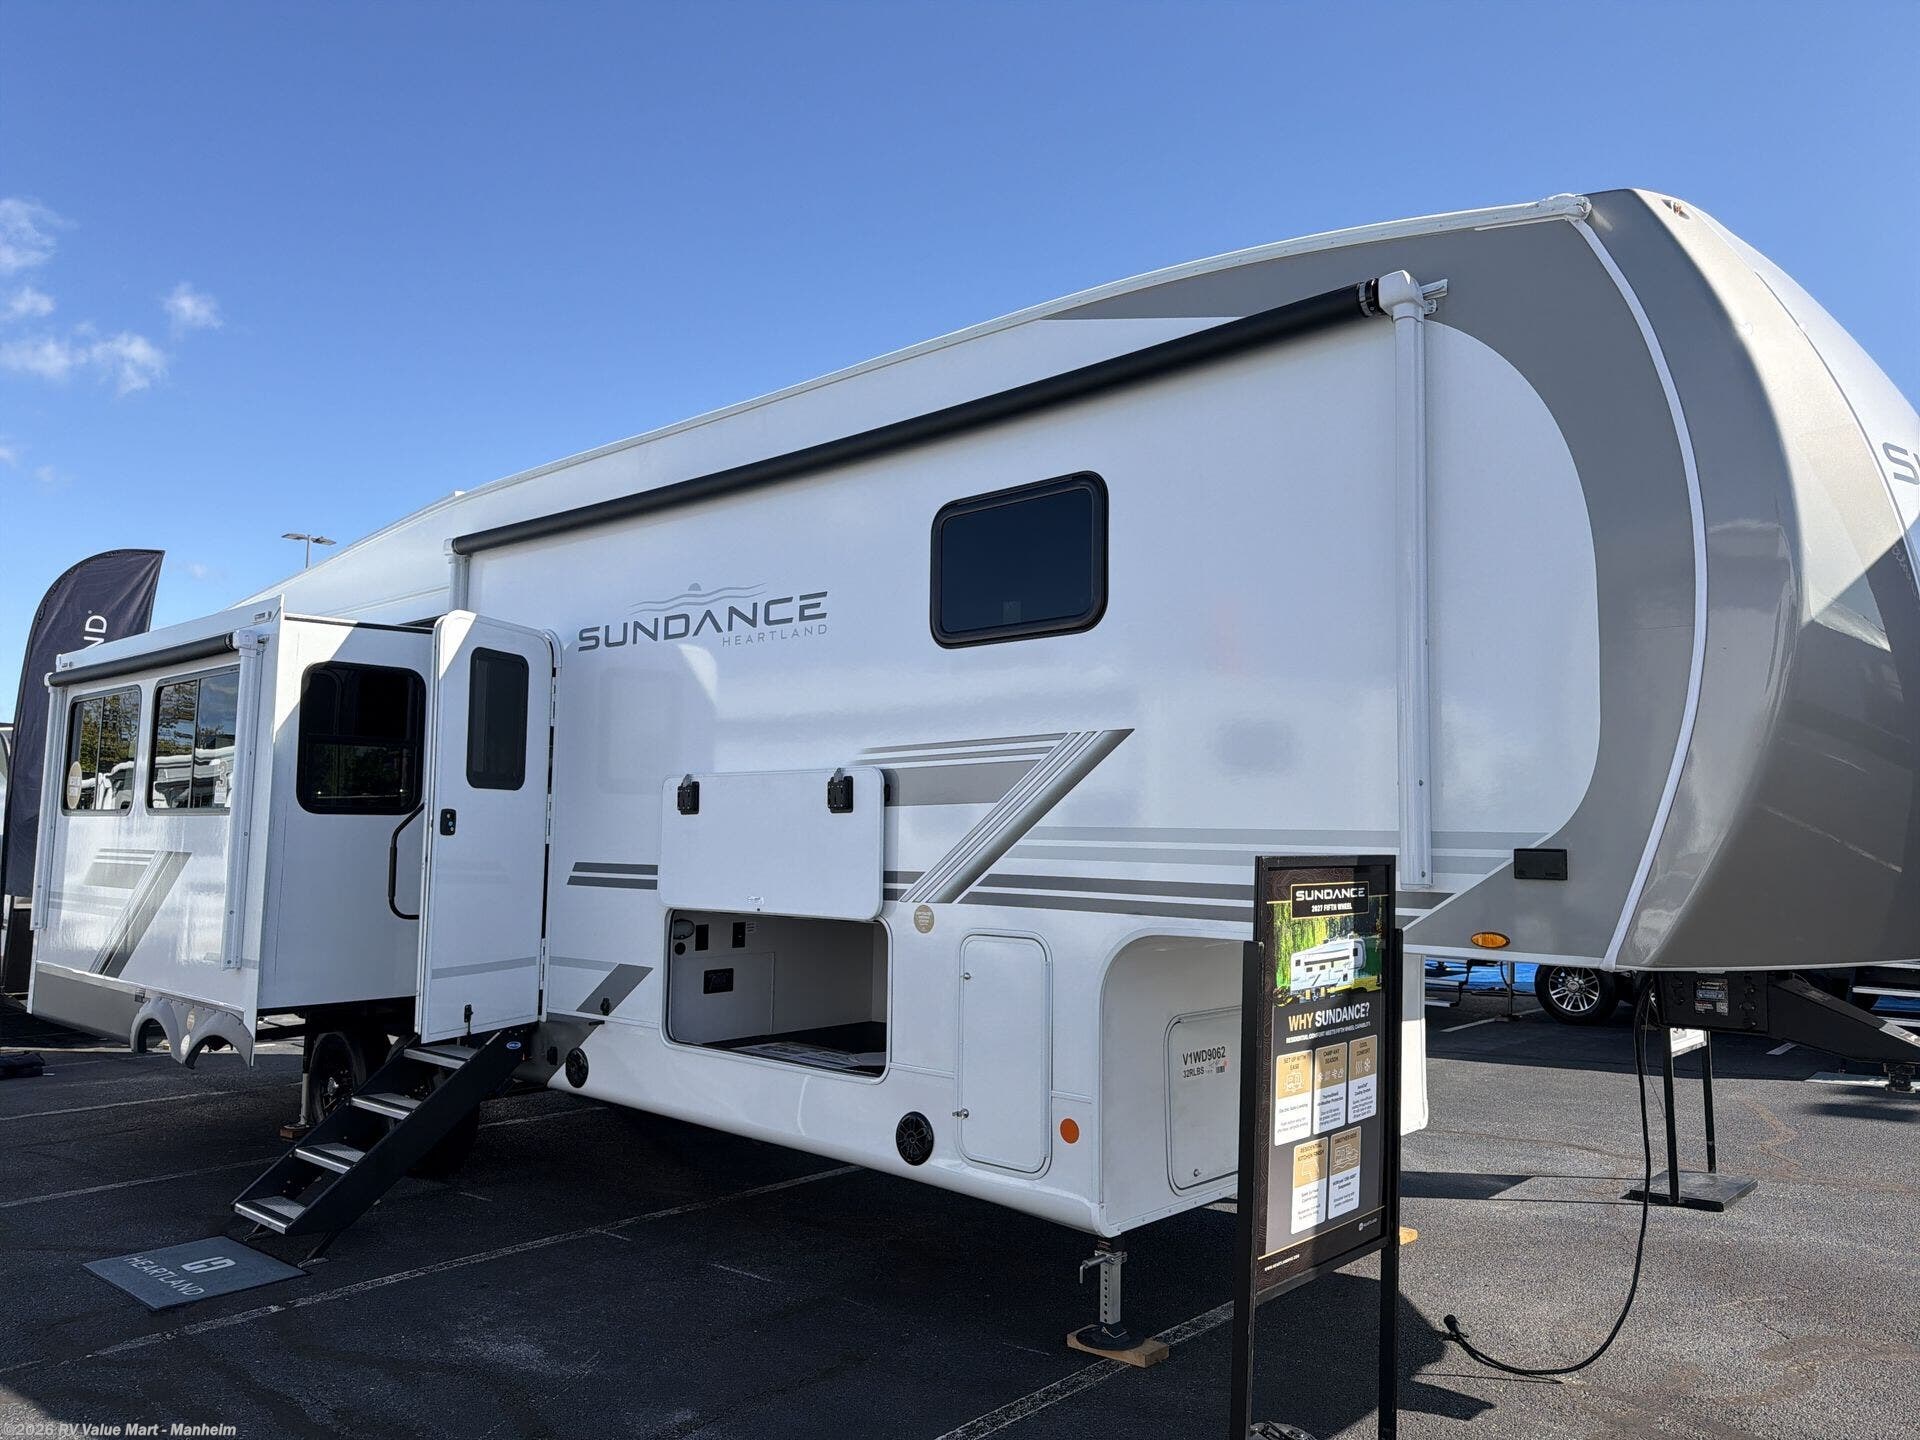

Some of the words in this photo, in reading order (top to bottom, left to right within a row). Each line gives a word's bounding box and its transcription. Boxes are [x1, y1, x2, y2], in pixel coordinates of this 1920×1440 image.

[1882, 442, 1920, 485] S
[578, 591, 828, 652] SUNDANCE
[722, 624, 828, 648] HEARTLAND
[1295, 887, 1365, 901] SUNDANCE
[1323, 903, 1337, 911] FIFTH
[1337, 902, 1352, 910] WHEEL
[1288, 1012, 1313, 1031] WHY
[1315, 1002, 1370, 1027] SUNDANCE?
[1182, 1046, 1226, 1066] V1WD9062
[1183, 1066, 1205, 1078] 32RLBS
[123, 1255, 205, 1296] HEARTLAND
